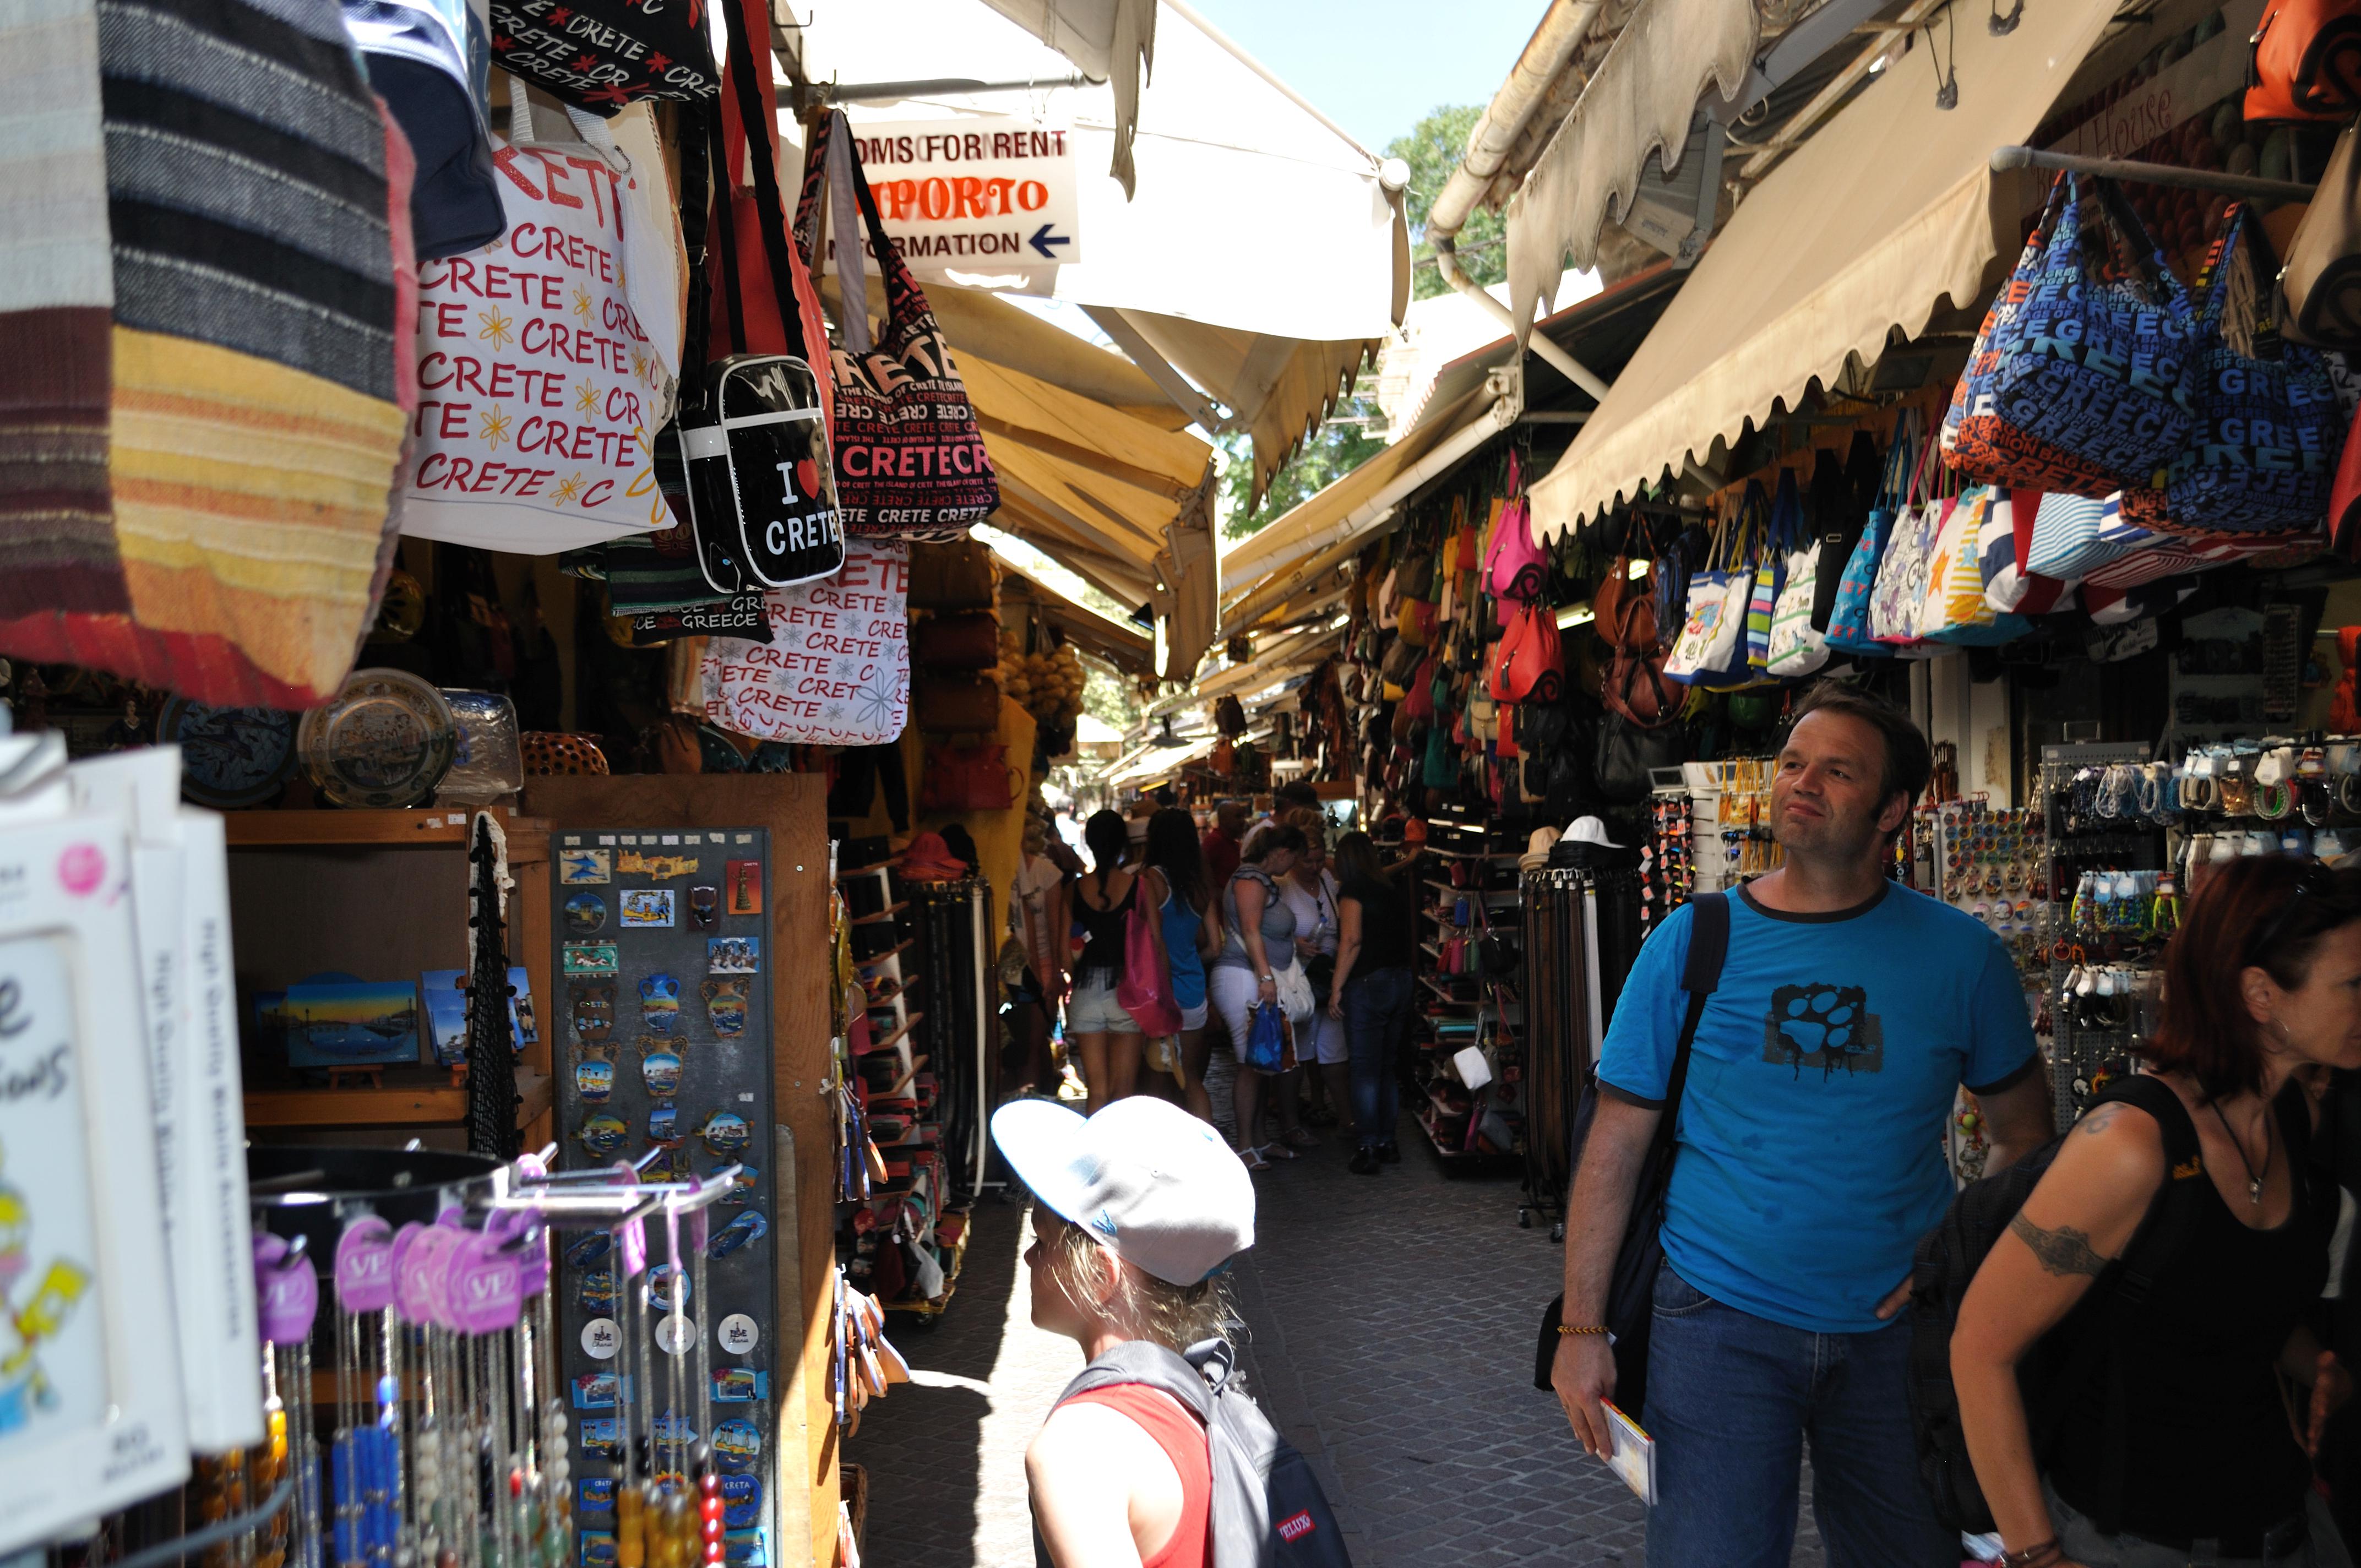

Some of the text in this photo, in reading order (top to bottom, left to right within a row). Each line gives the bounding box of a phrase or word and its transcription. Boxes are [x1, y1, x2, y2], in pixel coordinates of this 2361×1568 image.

[566, 15, 649, 61] CRETE
[505, 52, 598, 90] CRETE
[926, 134, 982, 162] FOR
[993, 129, 1067, 160] RENT
[512, 222, 612, 284] CRETE
[521, 318, 628, 374] CRETE
[417, 352, 643, 428] CRETE CR
[842, 388, 859, 396] THE
[910, 380, 936, 391] CRETE
[937, 405, 968, 420] CRETE
[2037, 370, 2182, 445] GREECE
[517, 416, 639, 467] CRETE
[857, 422, 900, 434] CRETE
[904, 422, 936, 433] CRETE
[416, 453, 614, 508] CRETE C
[878, 508, 932, 523] CRETE
[937, 507, 989, 522] CRETE
[766, 509, 839, 556] CRETE
[810, 588, 886, 613] CRETE
[682, 613, 758, 629] GREECE
[746, 646, 831, 674] CRETE
[806, 632, 881, 657] CRETE
[722, 665, 771, 683] ETE
[798, 678, 862, 700] CRET
[738, 687, 822, 717] CRETE
